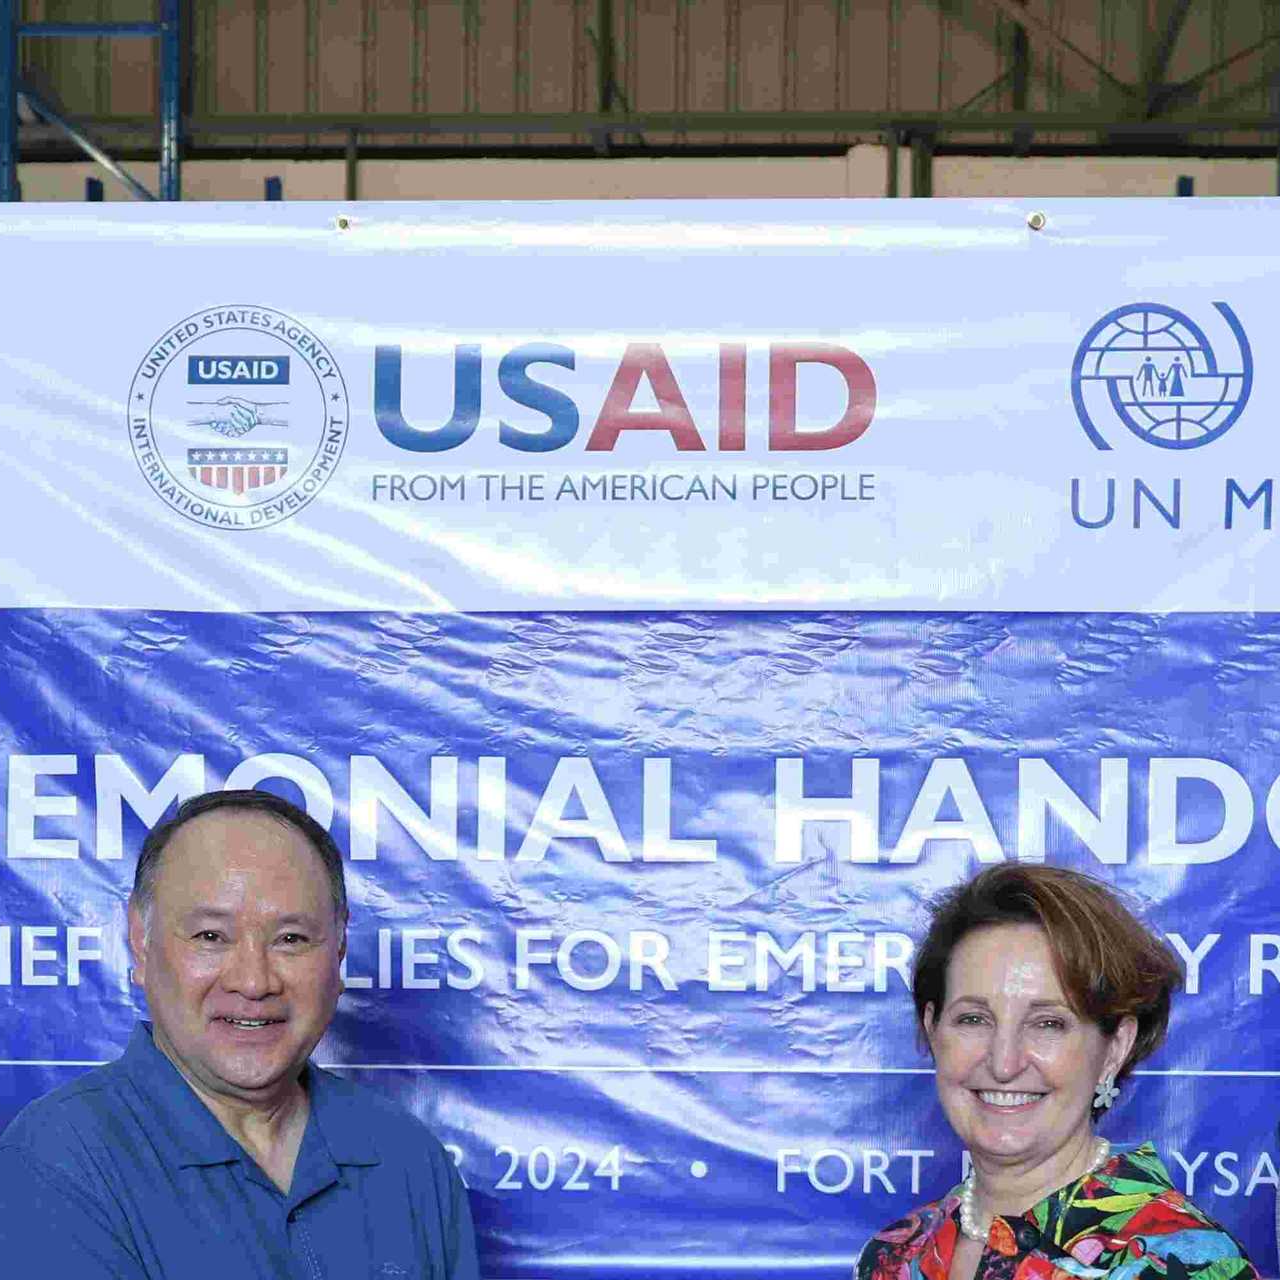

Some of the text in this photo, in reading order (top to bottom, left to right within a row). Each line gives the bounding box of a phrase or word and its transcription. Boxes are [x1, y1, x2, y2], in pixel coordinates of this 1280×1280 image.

[141, 310, 337, 380] UNITED STATES AGENCY
[198, 360, 279, 380] USAID
[374, 342, 878, 453] USAID
[133, 416, 343, 526] INTERNATIONAL DEVELOPMENT
[372, 474, 875, 501] FROM THE AMERICAN PEOPLE
[1071, 478, 1181, 529] UN
[516, 929, 678, 992] FOR
[707, 930, 1222, 996] EMERY
[495, 1145, 624, 1192] 2024
[776, 1147, 935, 1194] FORT
